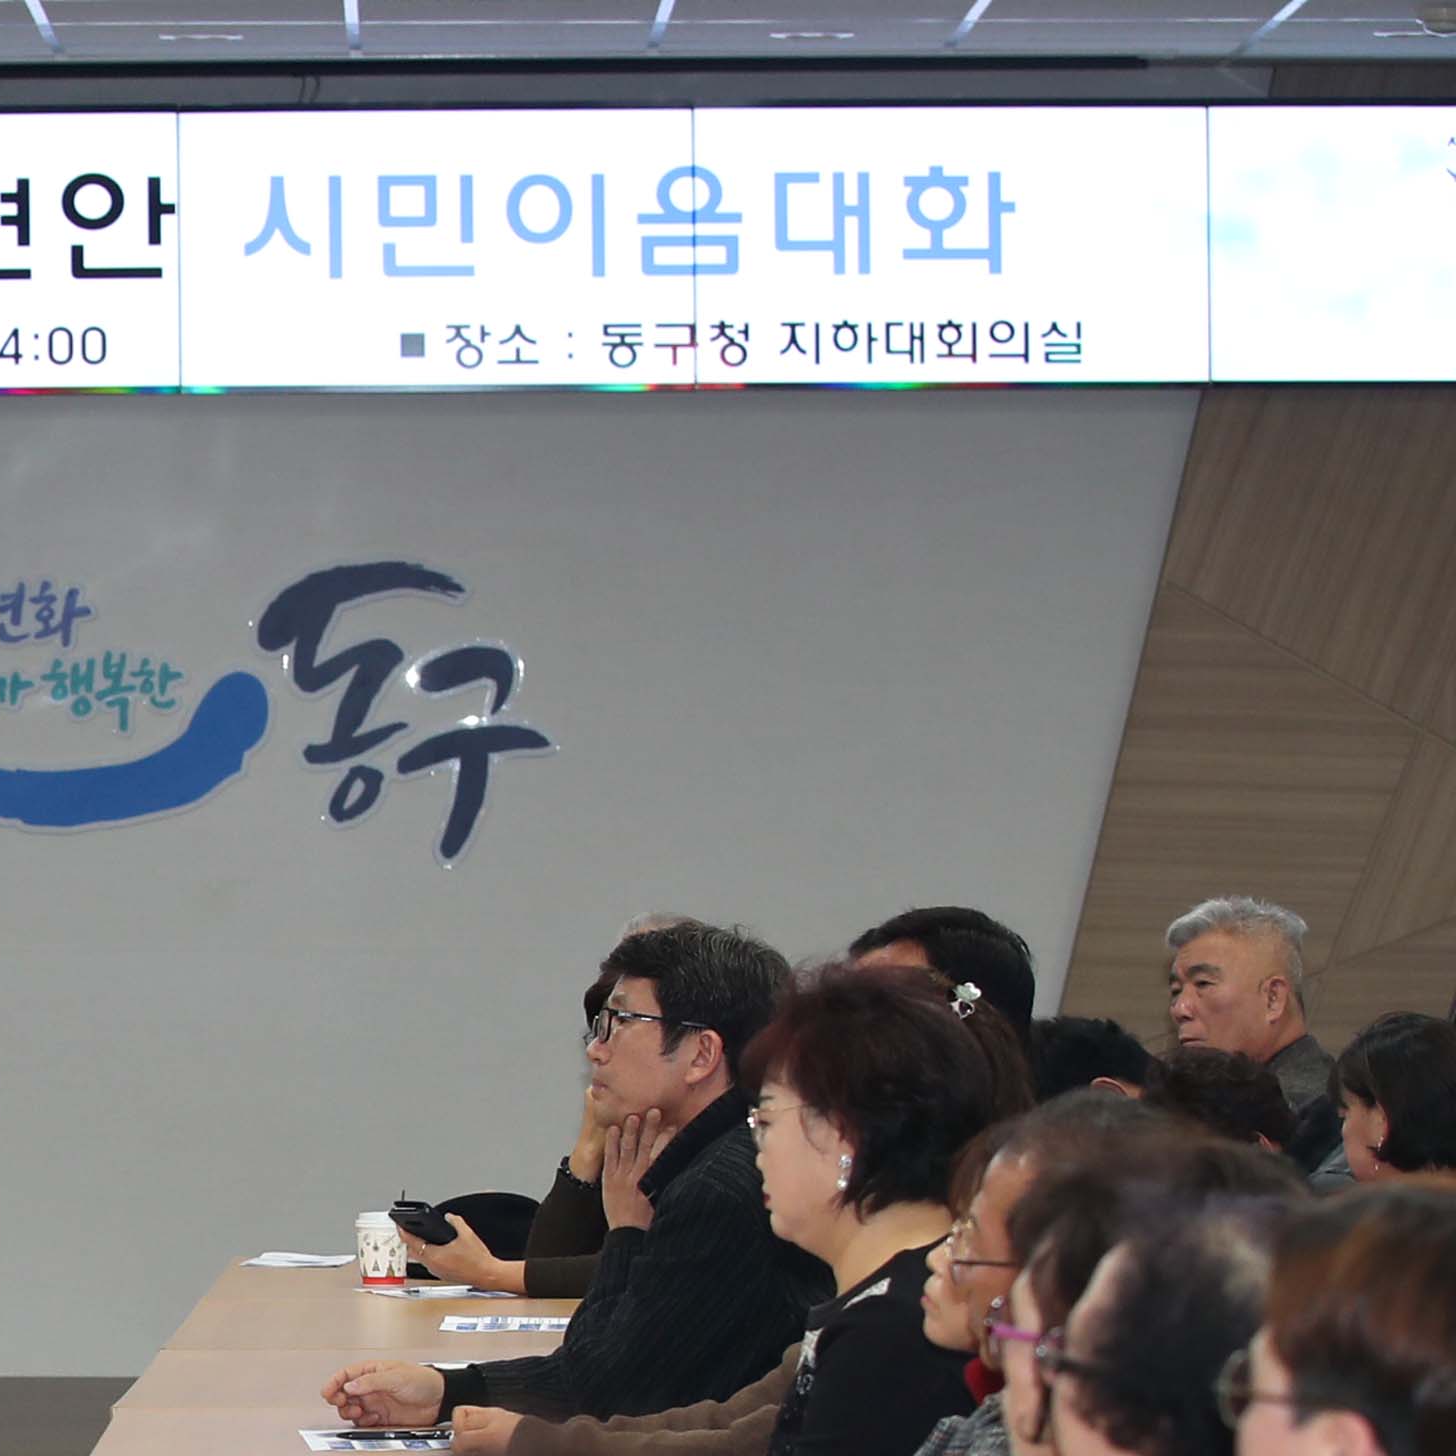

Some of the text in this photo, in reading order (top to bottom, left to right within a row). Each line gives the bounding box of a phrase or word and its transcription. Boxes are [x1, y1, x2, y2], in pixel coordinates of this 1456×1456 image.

[243, 164, 1017, 279] 시민이음대화
[446, 323, 540, 369] 장소
[601, 321, 750, 369] 동구청
[779, 319, 1084, 366] 지하대회의실
[40, 650, 183, 732] 행복한
[256, 560, 551, 860] 동구
